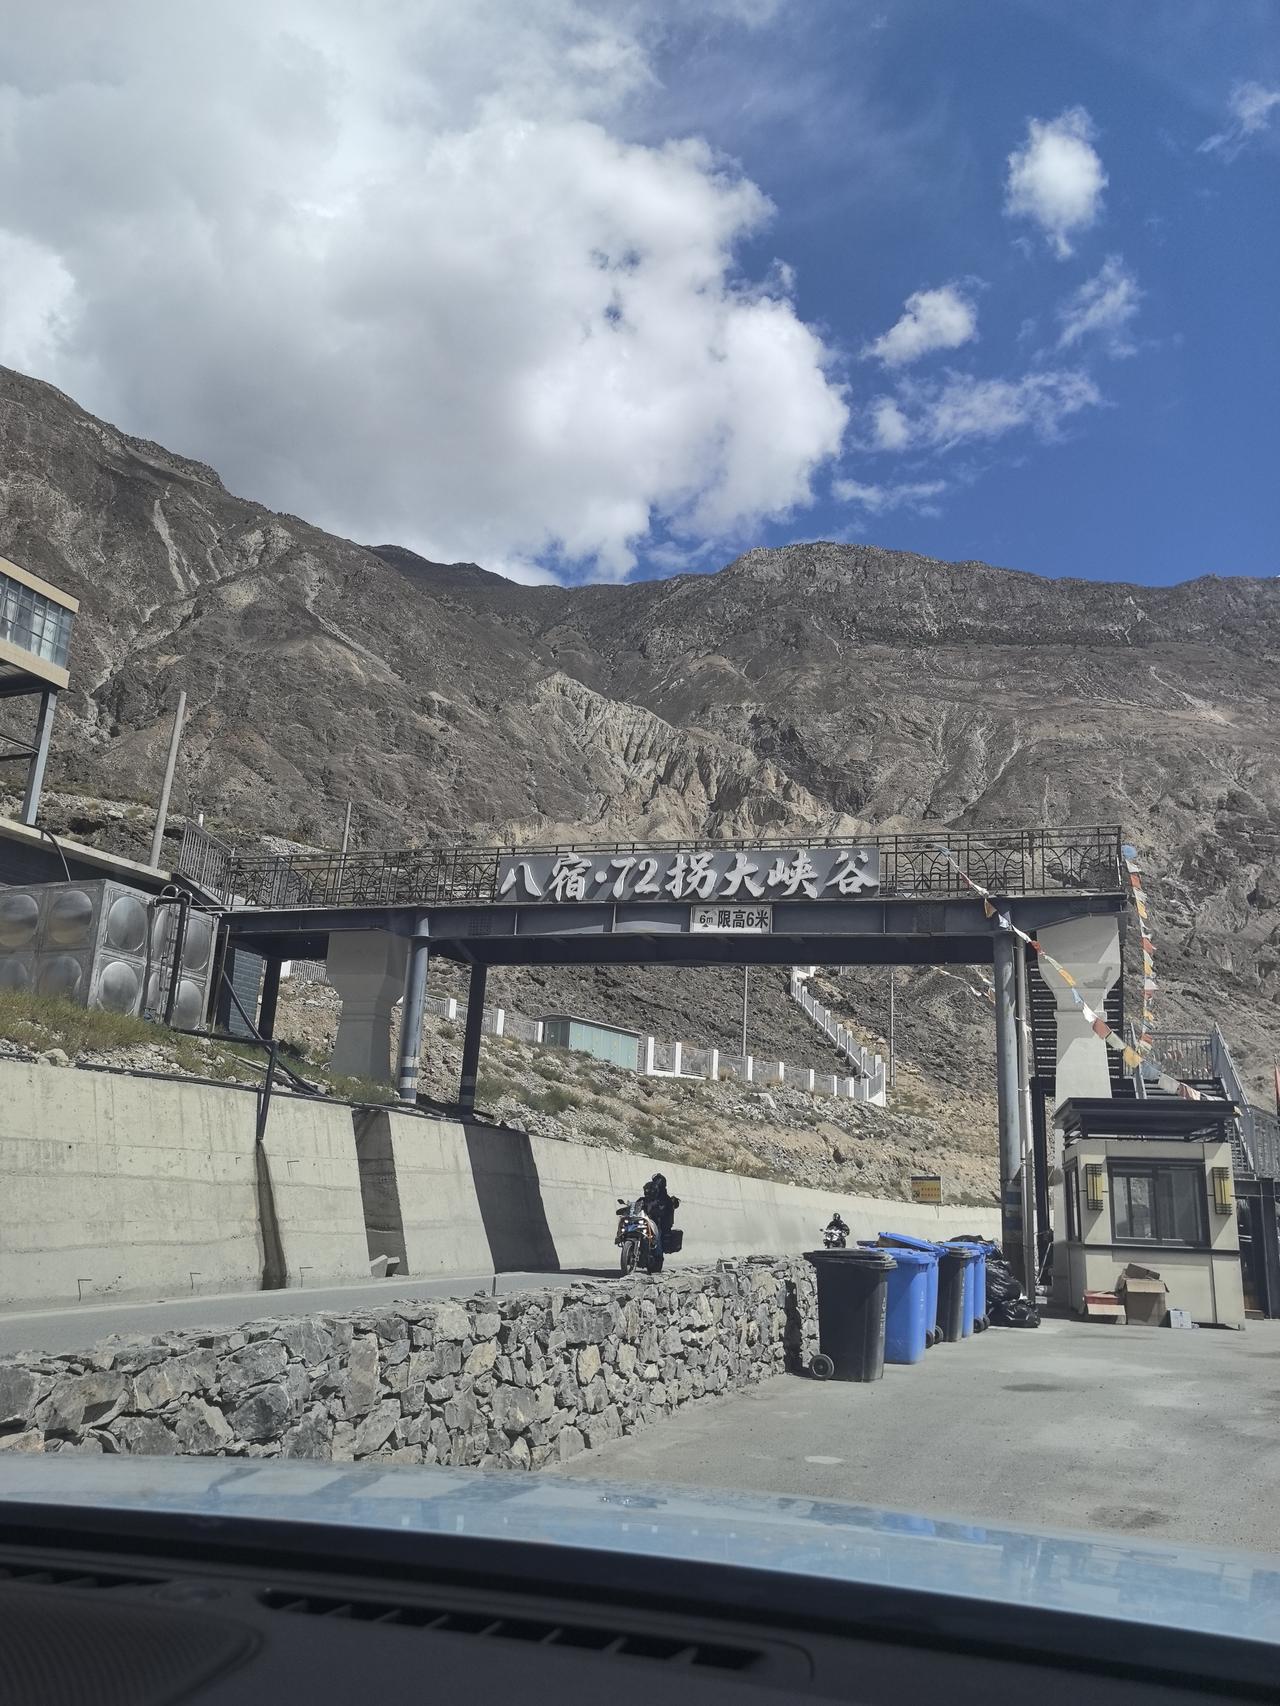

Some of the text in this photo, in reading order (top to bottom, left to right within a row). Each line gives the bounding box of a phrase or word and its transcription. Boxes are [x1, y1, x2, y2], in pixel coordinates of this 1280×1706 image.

[700, 914, 714, 924] 6m
[717, 909, 769, 928] 限高6米
